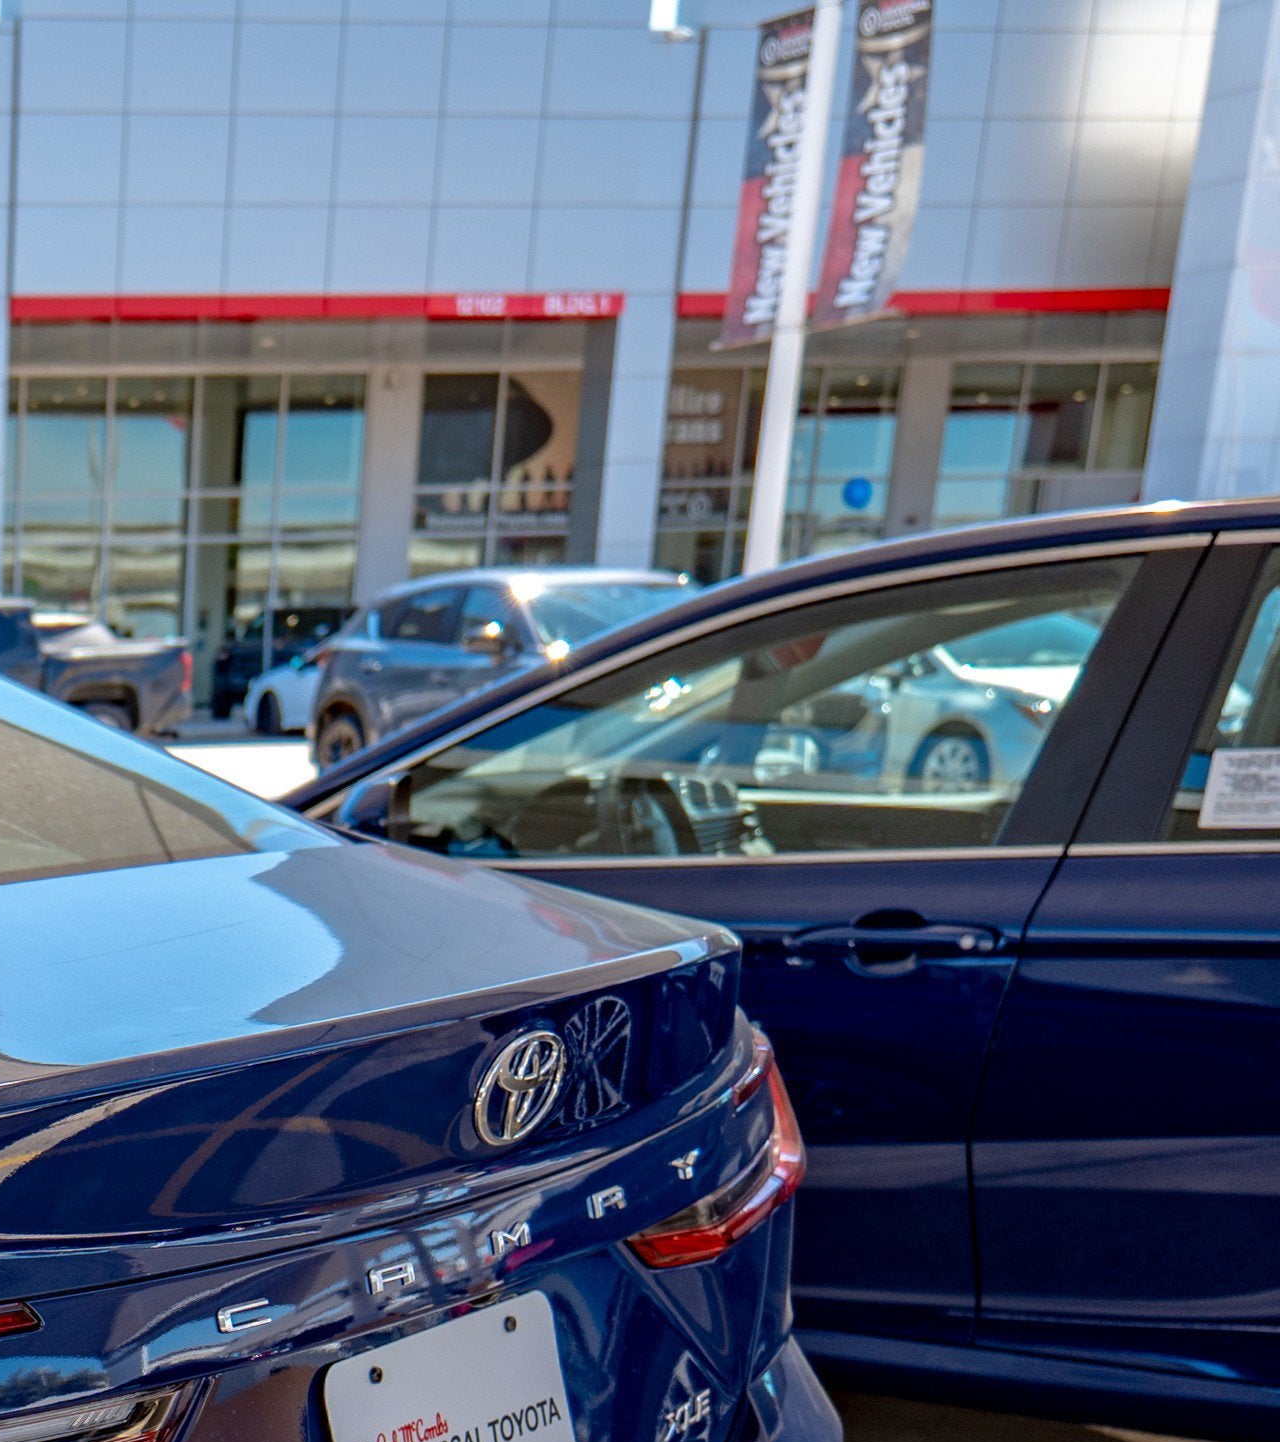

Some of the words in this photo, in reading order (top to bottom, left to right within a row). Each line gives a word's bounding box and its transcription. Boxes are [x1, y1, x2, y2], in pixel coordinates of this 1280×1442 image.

[853, 61, 909, 223] Vehicles
[834, 226, 888, 308] New
[217, 1147, 701, 1335] CAMRY
